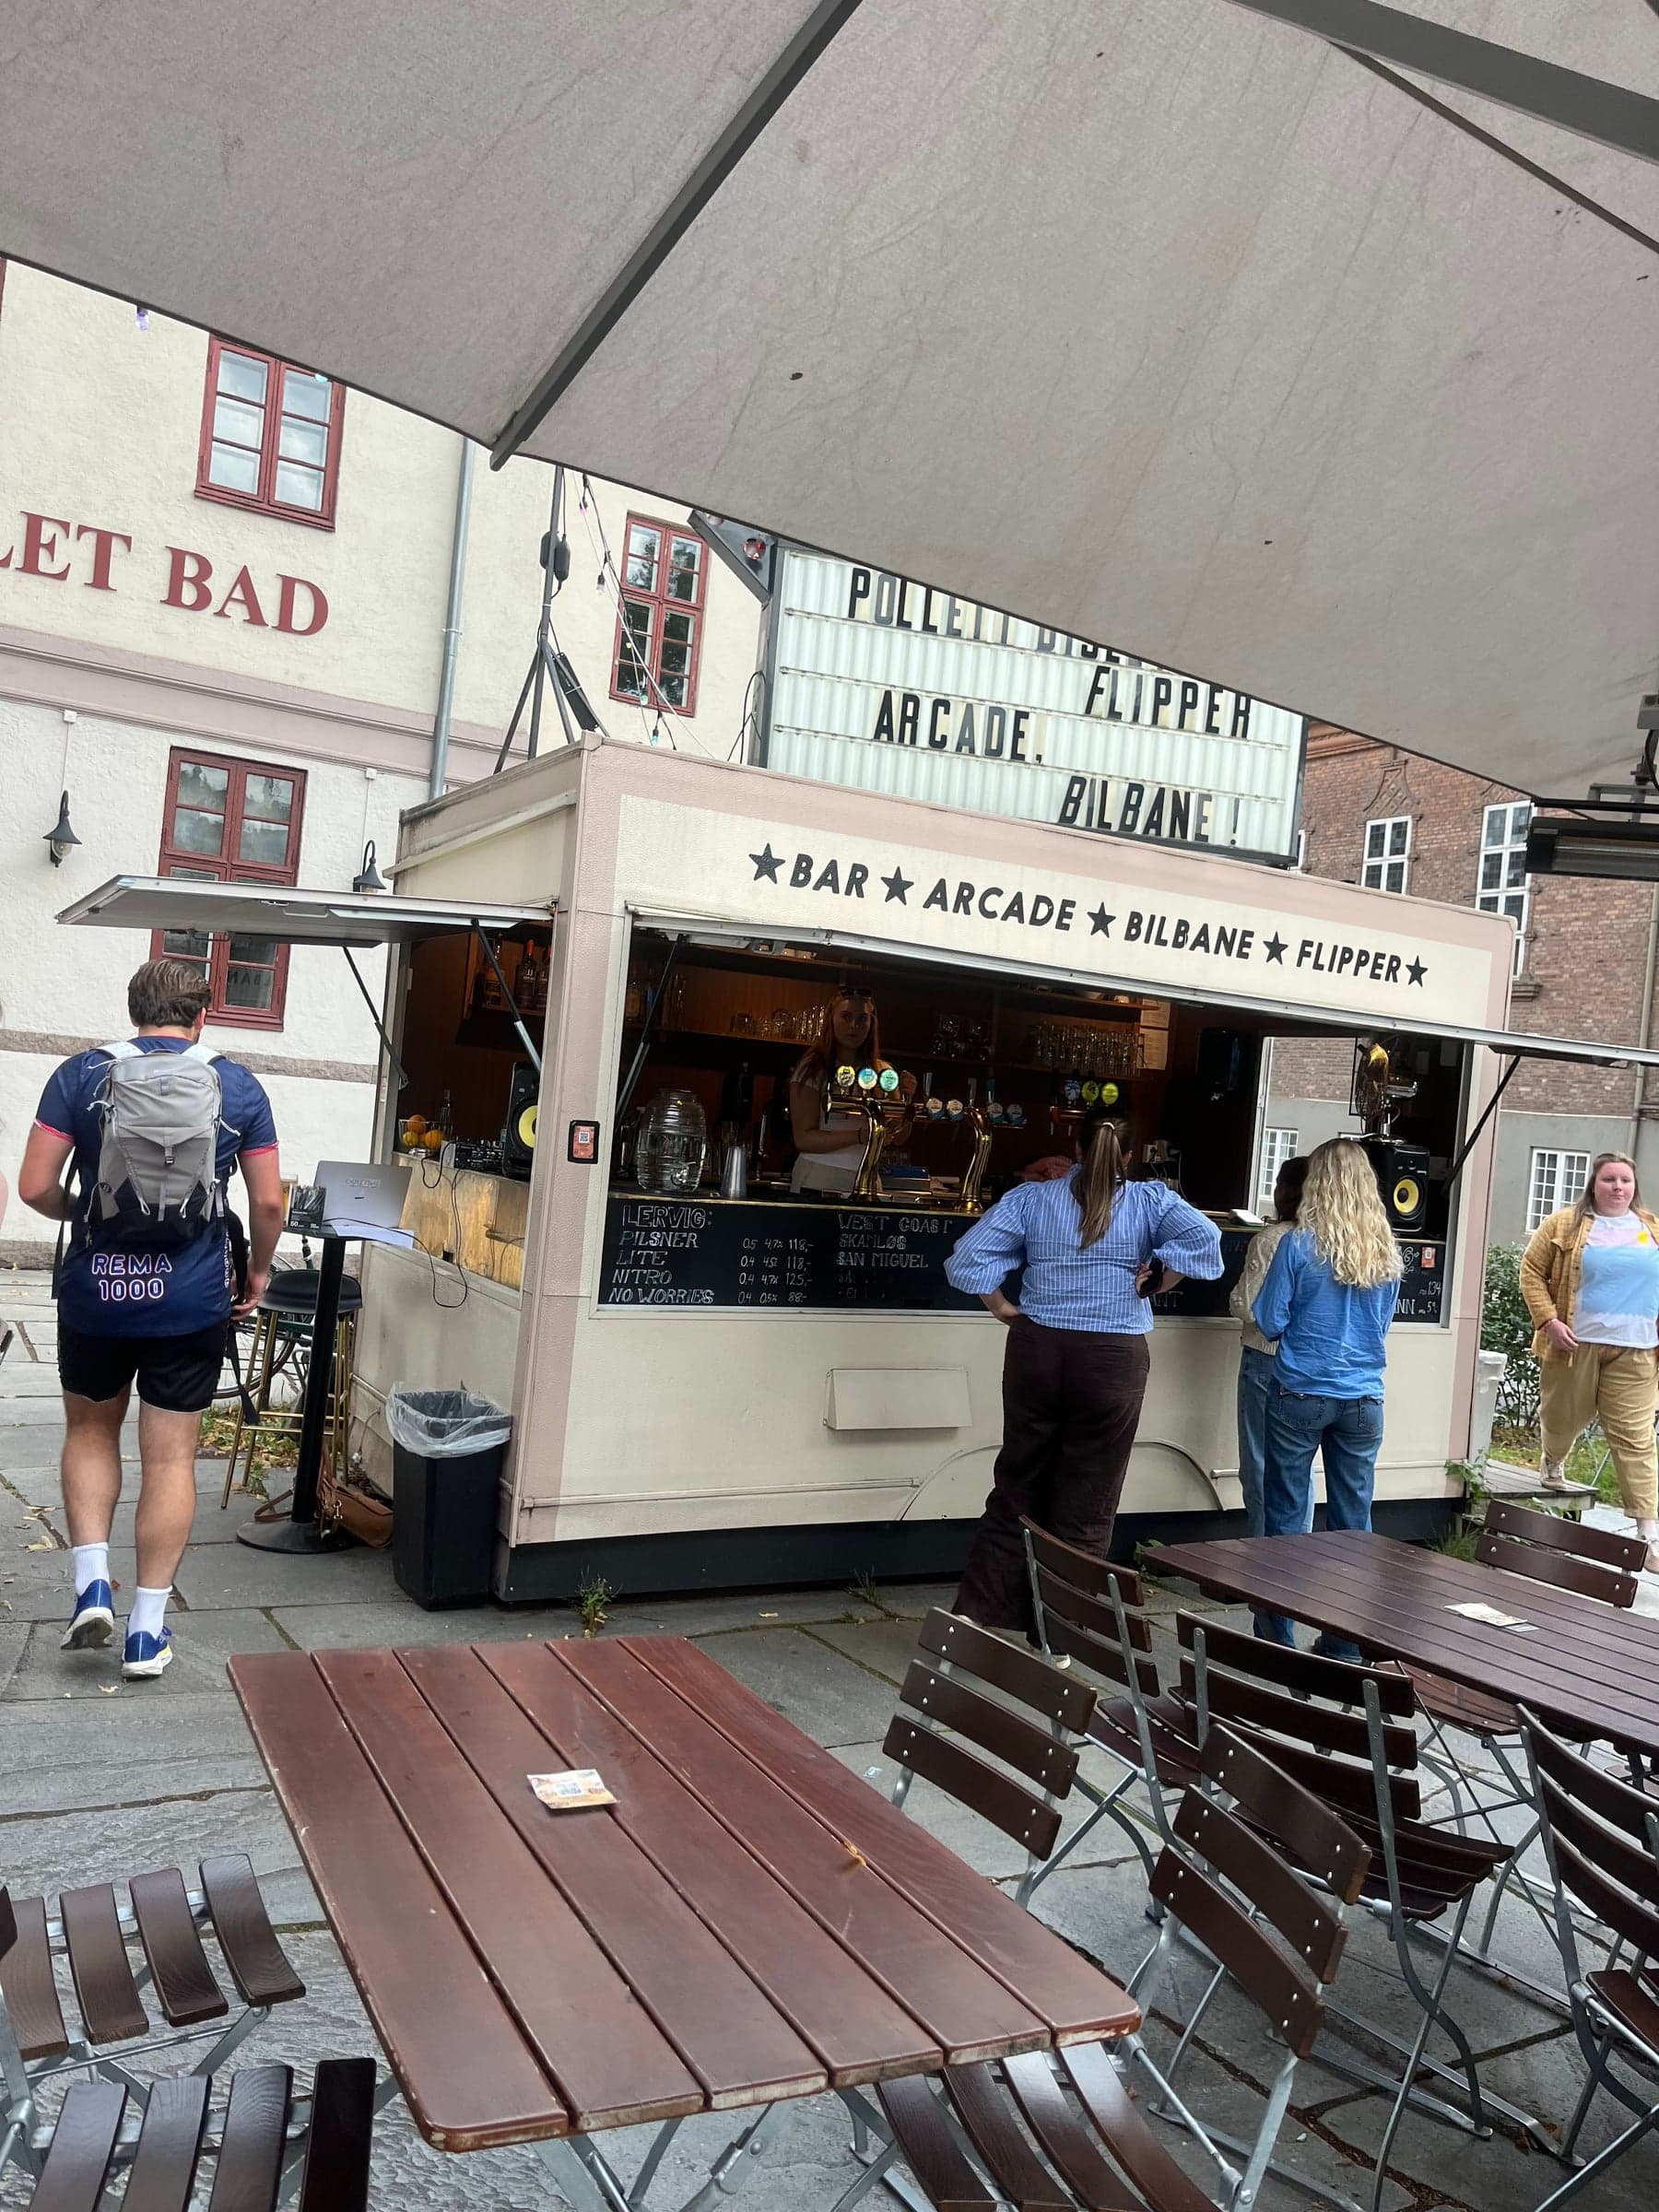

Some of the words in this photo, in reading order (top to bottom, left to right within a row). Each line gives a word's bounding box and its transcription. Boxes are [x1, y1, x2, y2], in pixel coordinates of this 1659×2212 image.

[0, 511, 133, 593] ET
[159, 545, 330, 637] BAD
[1084, 665, 1252, 741] FLIPPER
[873, 689, 1043, 764] ARCADE,
[789, 853, 869, 899] BAR
[922, 877, 1077, 931] ARCADE
[1124, 910, 1255, 959] BILBANE
[1296, 939, 1402, 983] FLIPPER
[899, 1217, 953, 1234] COAST
[618, 1230, 700, 1248] PILSNER
[91, 1253, 172, 1276] REMA
[616, 1249, 668, 1265] LITE
[837, 1251, 865, 1266] SAN
[871, 1253, 928, 1268] MIGUEL
[612, 1269, 673, 1285] NITRO
[98, 1277, 165, 1301] 1000
[608, 1288, 633, 1302] NO
[637, 1288, 714, 1304] WORRIES
